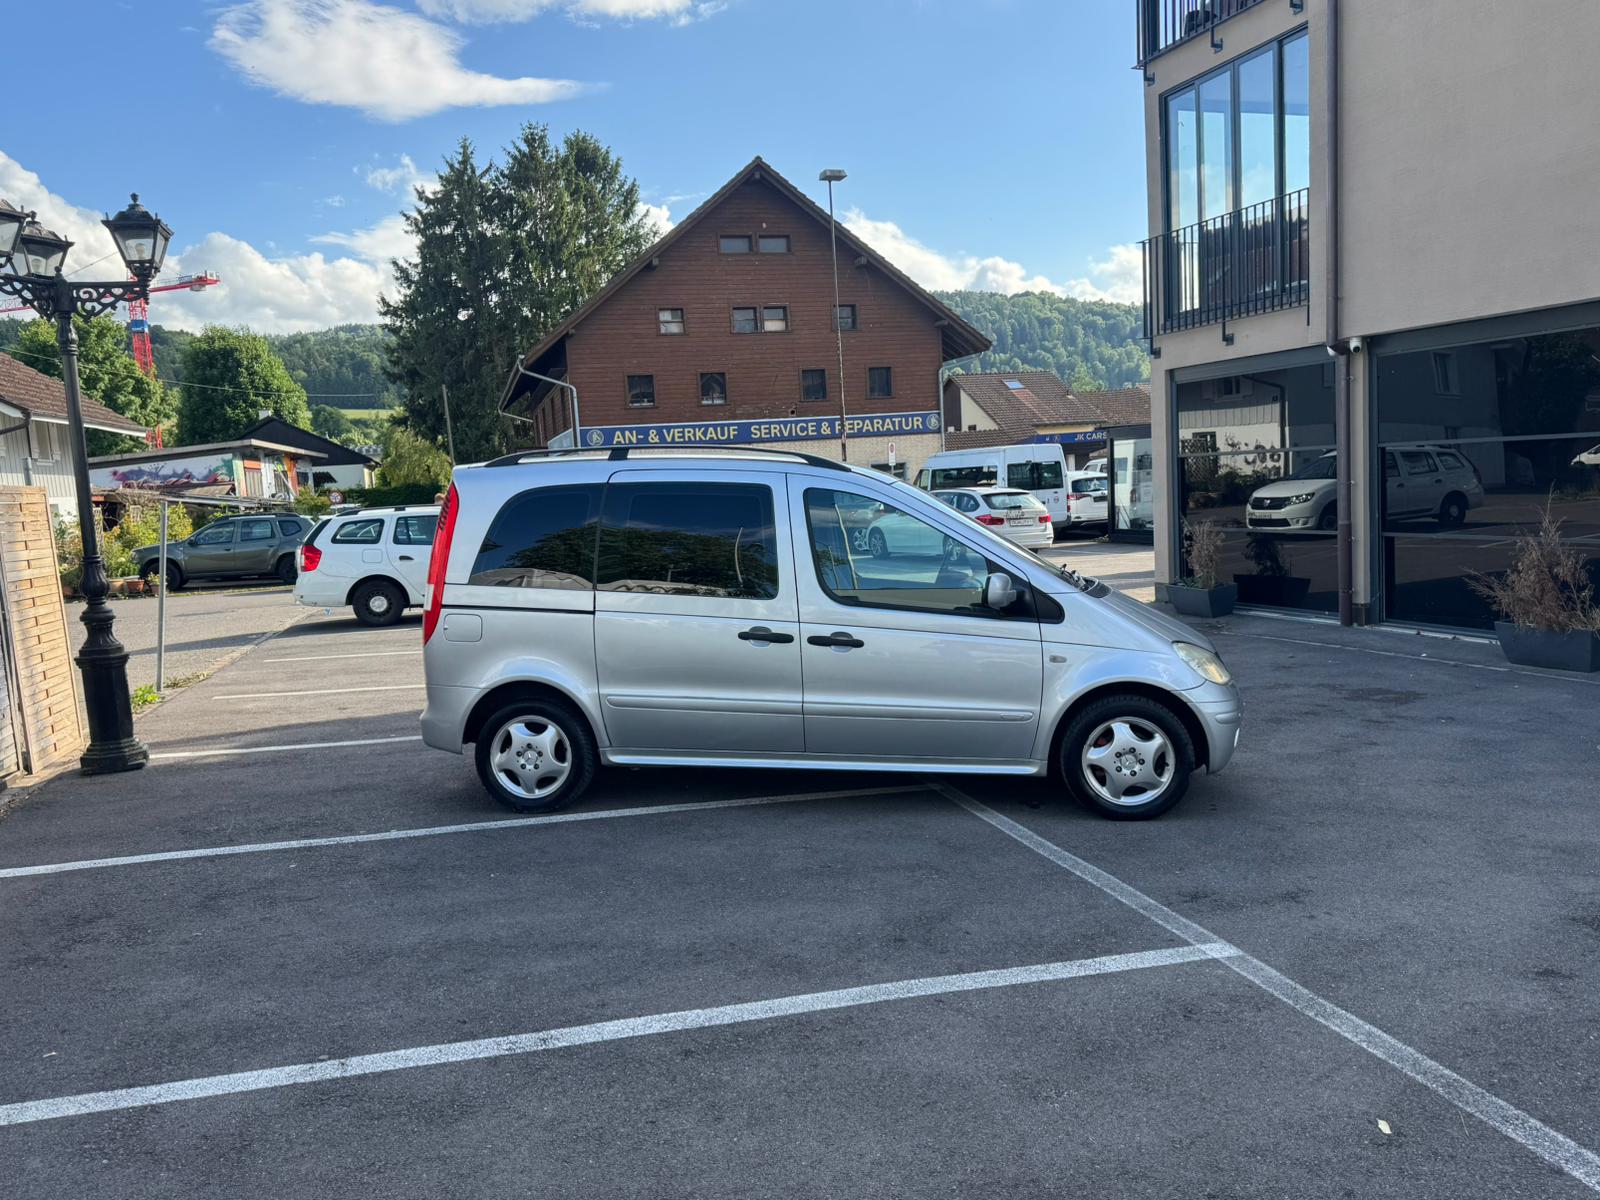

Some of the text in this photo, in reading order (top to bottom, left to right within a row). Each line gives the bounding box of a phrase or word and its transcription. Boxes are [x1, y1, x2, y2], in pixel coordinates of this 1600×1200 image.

[613, 430, 644, 445] AN-
[648, 429, 659, 443] &
[663, 427, 738, 443] VERKAUF
[751, 422, 817, 438] SERVICE
[820, 421, 831, 435] &
[1074, 433, 1085, 441] JK
